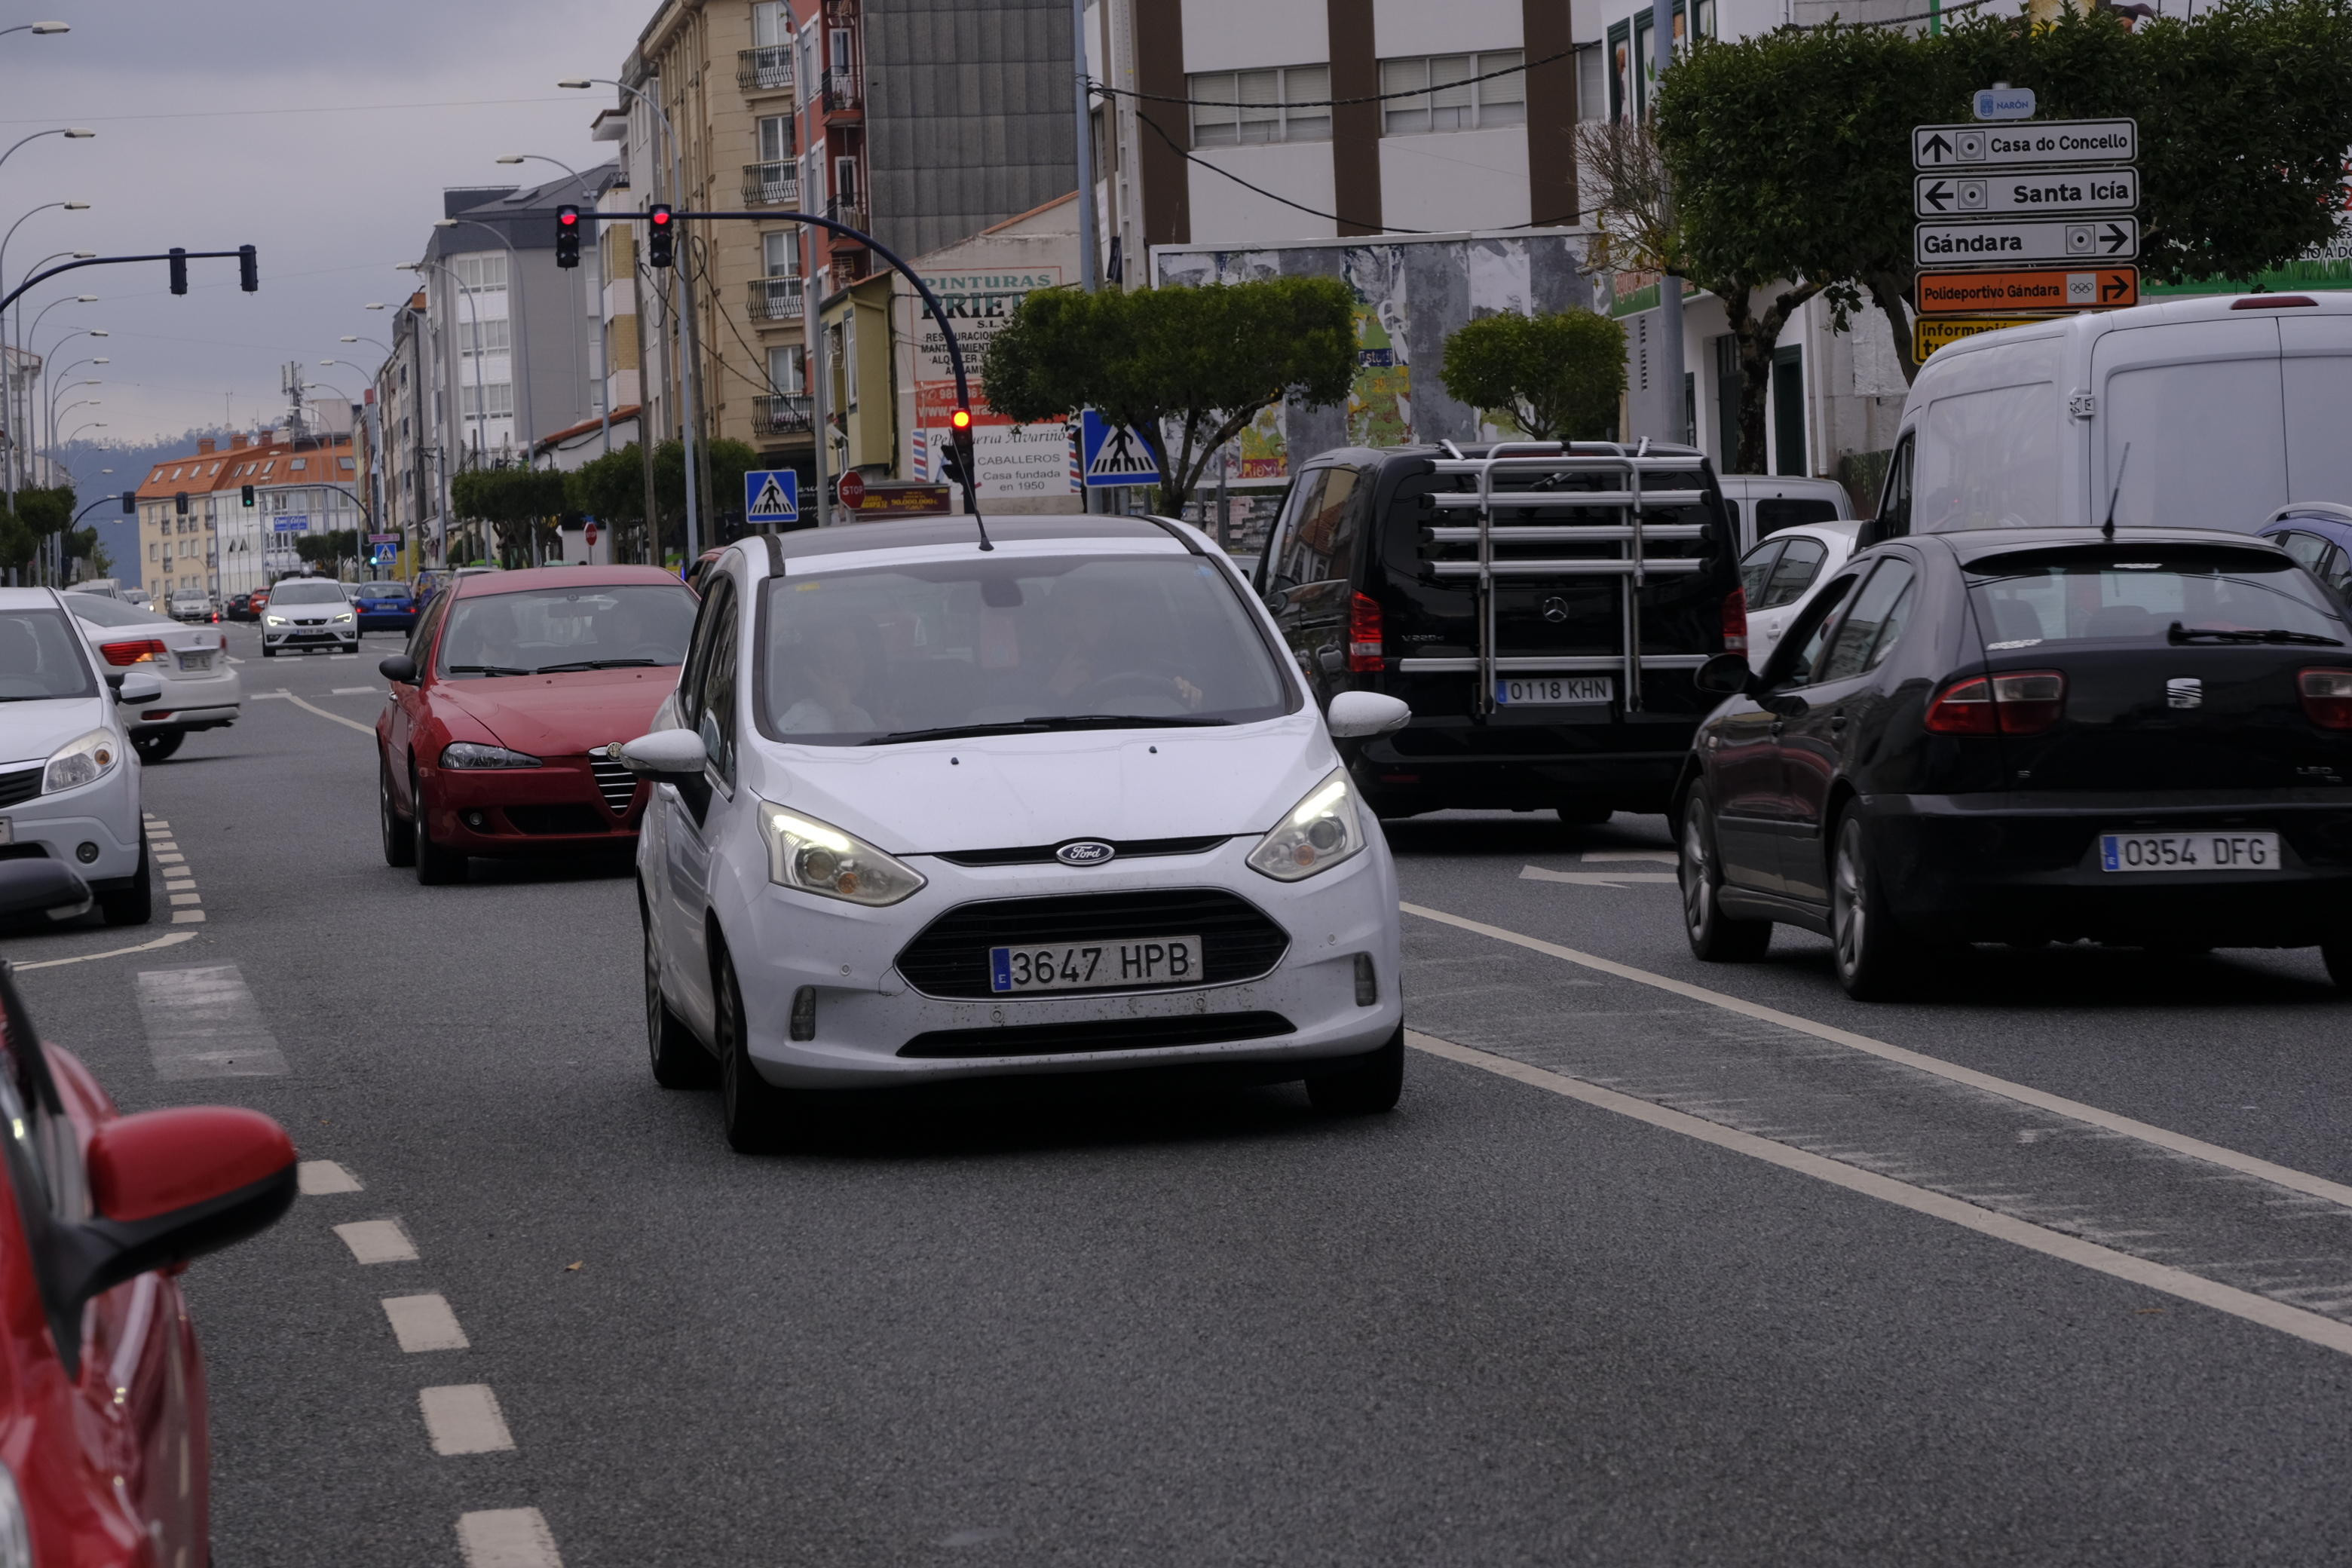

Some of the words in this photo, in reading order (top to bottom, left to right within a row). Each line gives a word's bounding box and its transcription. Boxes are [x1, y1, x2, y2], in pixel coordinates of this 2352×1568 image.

[1996, 99, 2029, 109] NARÓN
[1991, 138, 2031, 152] Casa
[2035, 137, 2055, 151] do
[2059, 134, 2127, 150] Concello
[2014, 184, 2082, 203] Santa
[2090, 180, 2129, 201] Icía
[1924, 233, 2023, 253] Gándara
[920, 274, 1051, 290] PINTURAS
[1925, 286, 2004, 303] Polideportivo
[2007, 283, 2060, 299] Gándara
[920, 291, 1027, 320] PRIET
[976, 320, 1000, 329] S.L.
[932, 354, 977, 365] ALQLER
[978, 454, 1061, 465] CABALLEROS
[982, 472, 1012, 481] Casa
[1015, 470, 1061, 479] fundada
[843, 485, 863, 495] STOP
[1018, 481, 1045, 490] 1950
[1511, 681, 1561, 700] 0118
[1567, 680, 1607, 699] KHN
[1070, 845, 1102, 859] Ford
[2125, 838, 2197, 866] 0354
[2213, 837, 2266, 865] DFG
[998, 972, 1008, 985] E
[1012, 947, 1103, 985] 3647
[1120, 942, 1190, 979] HPB
